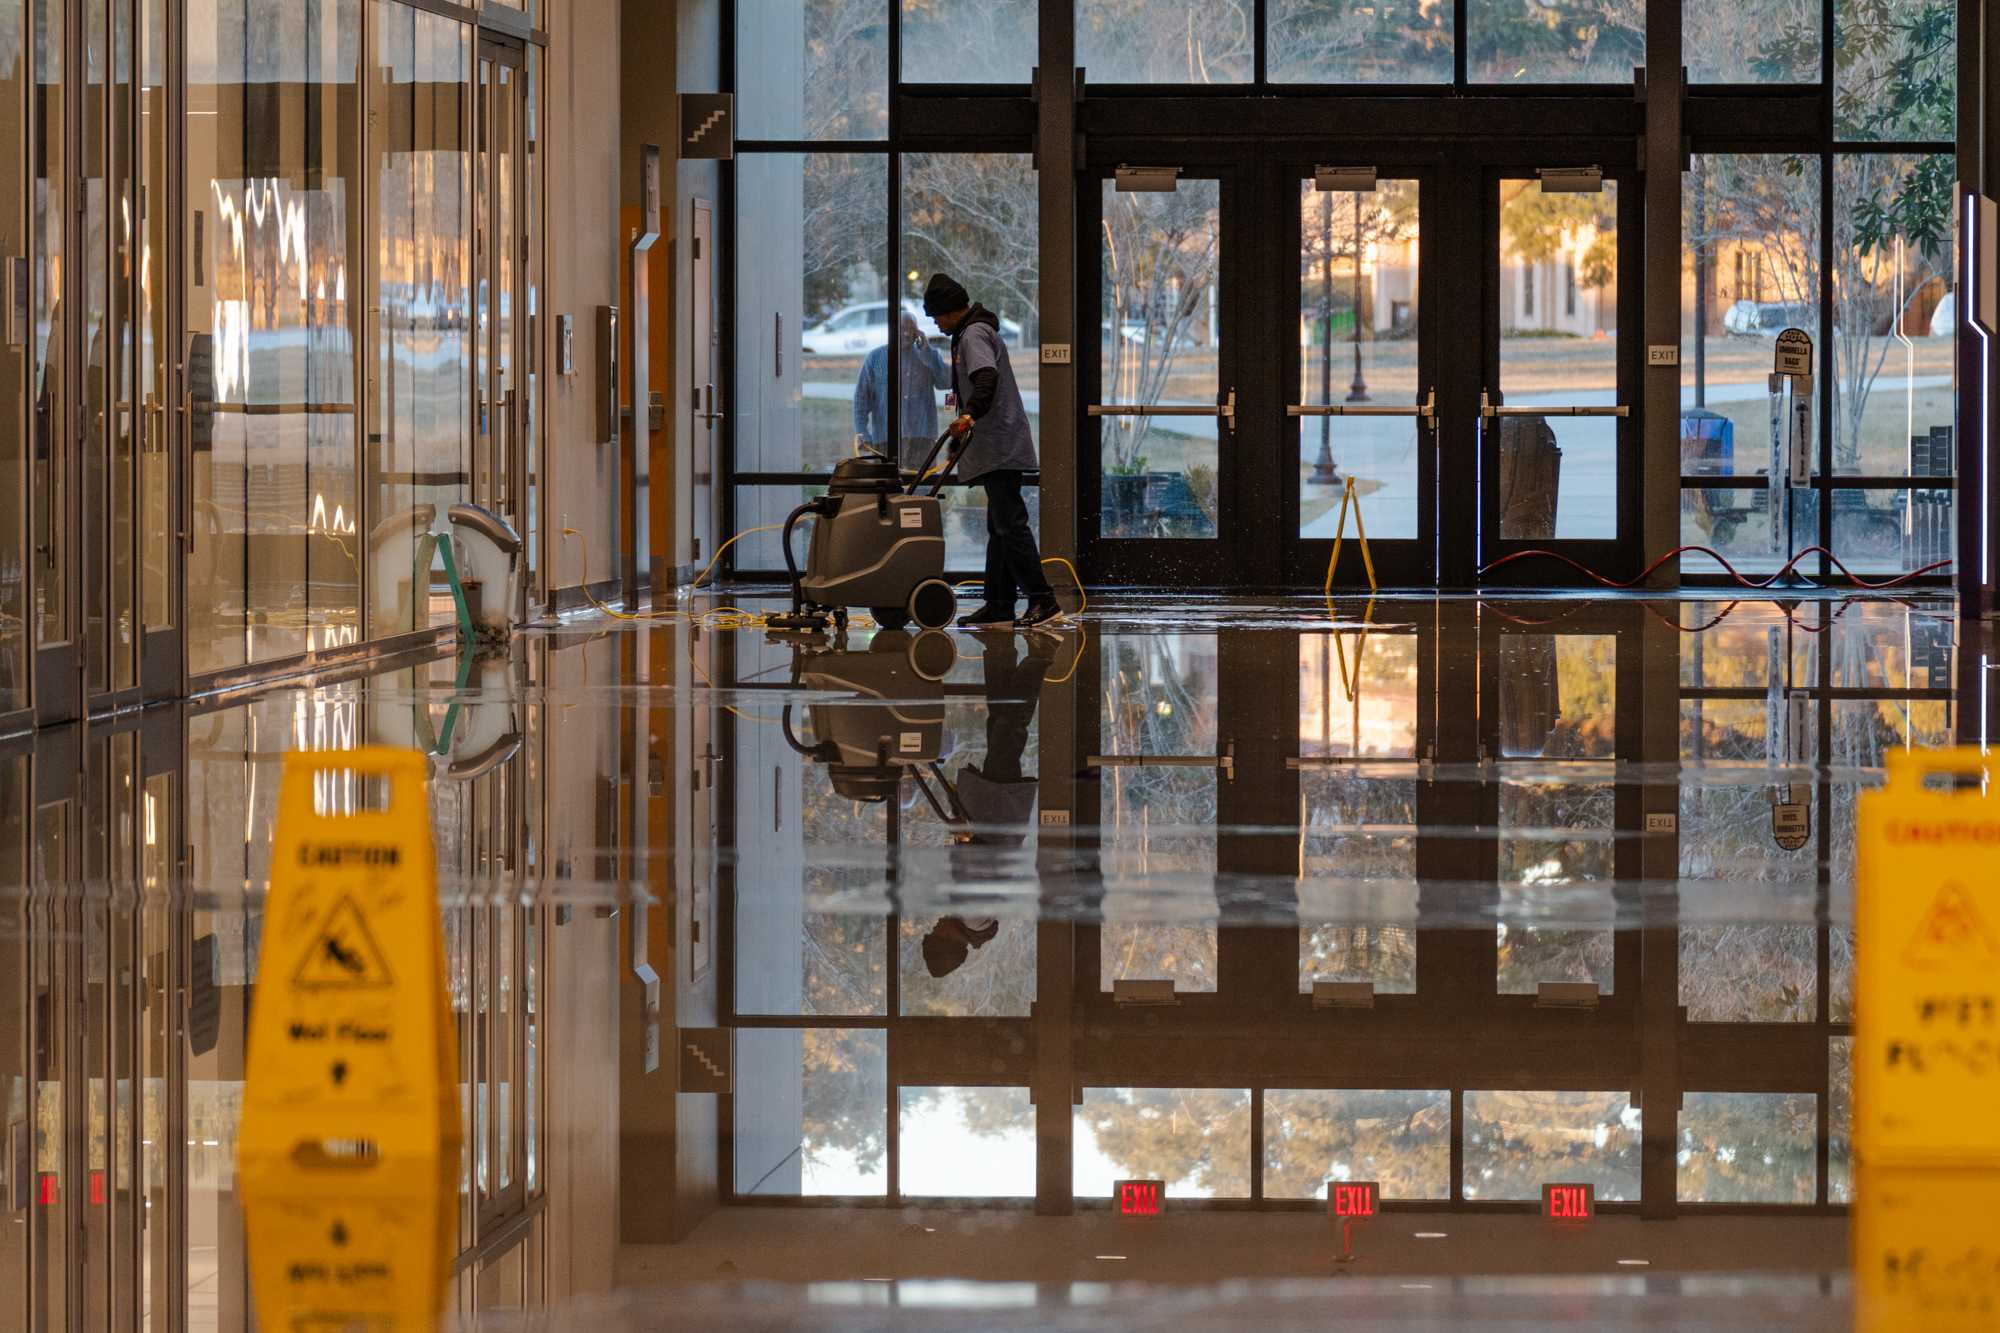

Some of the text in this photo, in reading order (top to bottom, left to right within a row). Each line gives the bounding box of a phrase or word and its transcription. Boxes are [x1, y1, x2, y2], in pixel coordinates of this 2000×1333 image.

[1044, 349, 1068, 359] EXIT
[1651, 350, 1675, 360] EXIT
[298, 843, 401, 866] CAUTION
